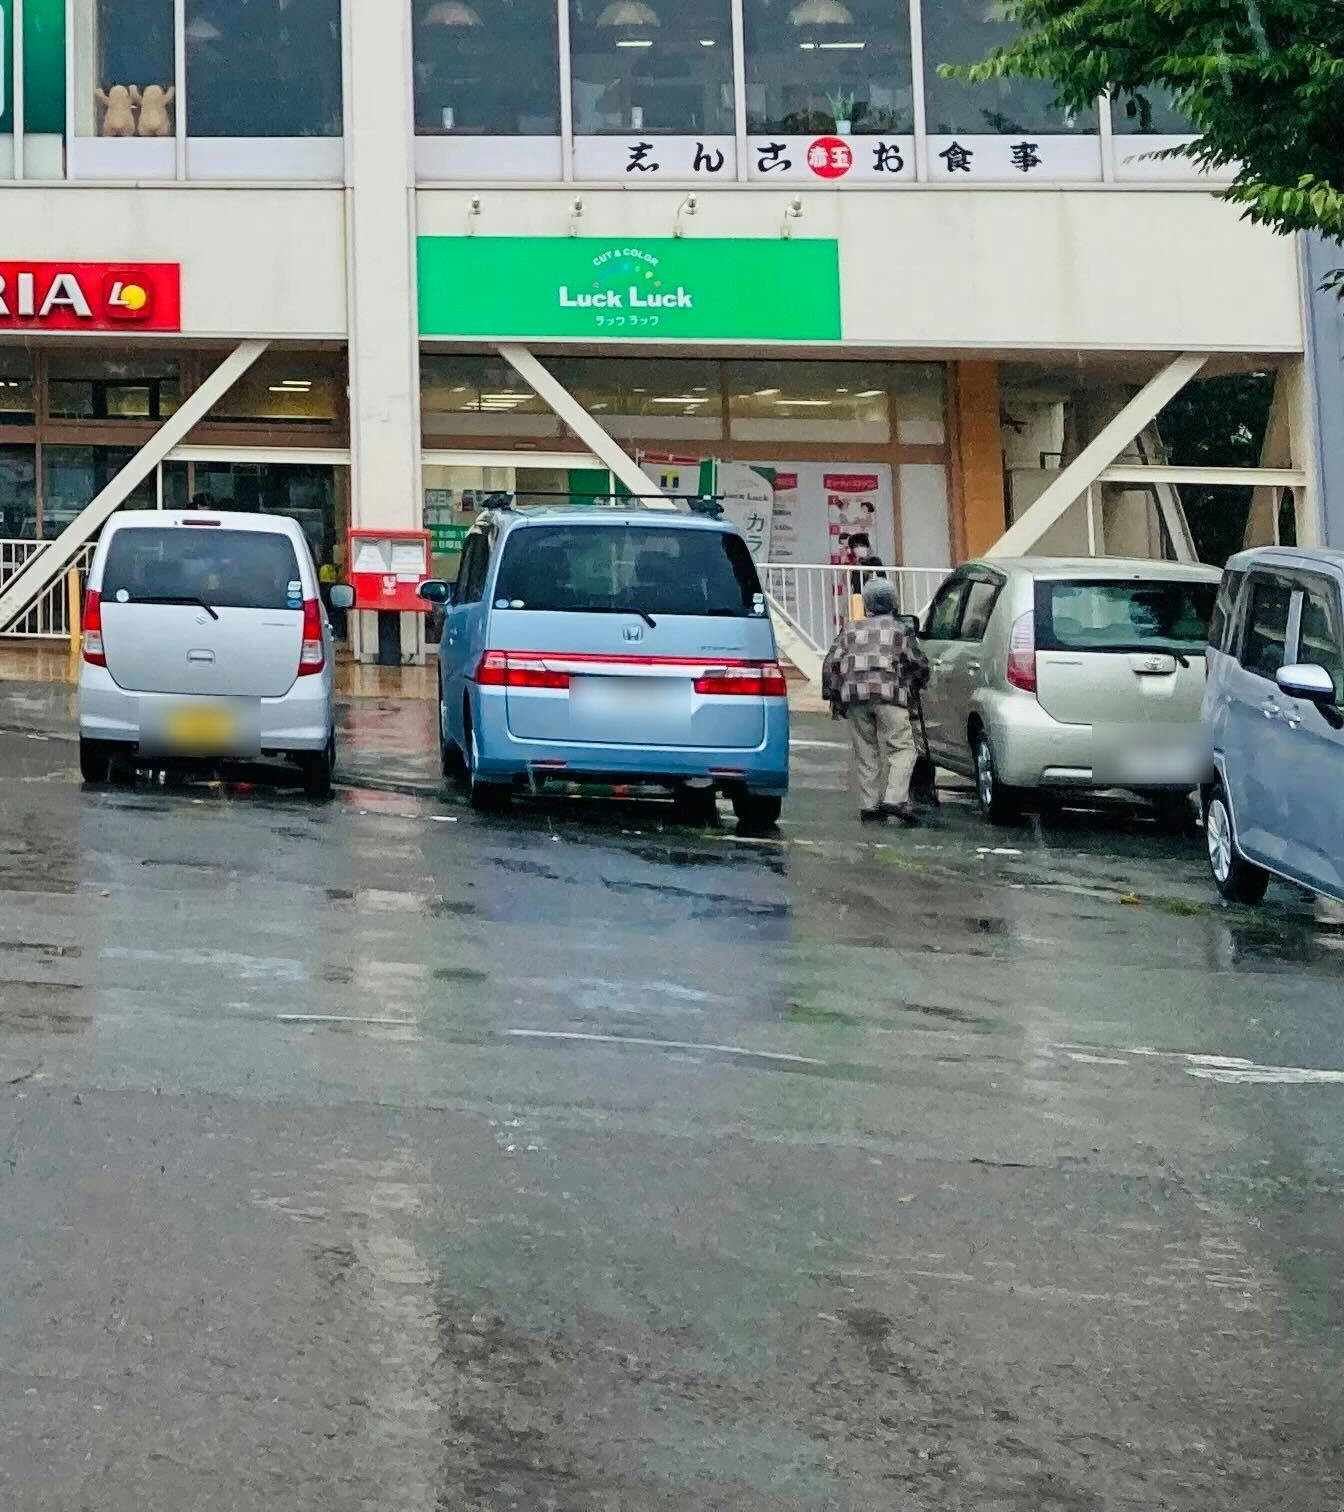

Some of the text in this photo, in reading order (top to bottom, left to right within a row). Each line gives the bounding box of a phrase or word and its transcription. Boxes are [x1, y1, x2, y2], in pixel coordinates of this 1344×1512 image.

[872, 140, 1043, 173] お食事
[592, 250, 612, 266] CUT
[623, 248, 659, 267] COLOR
[559, 286, 693, 308] Luck Luck
[595, 314, 660, 327] ラック ラック
